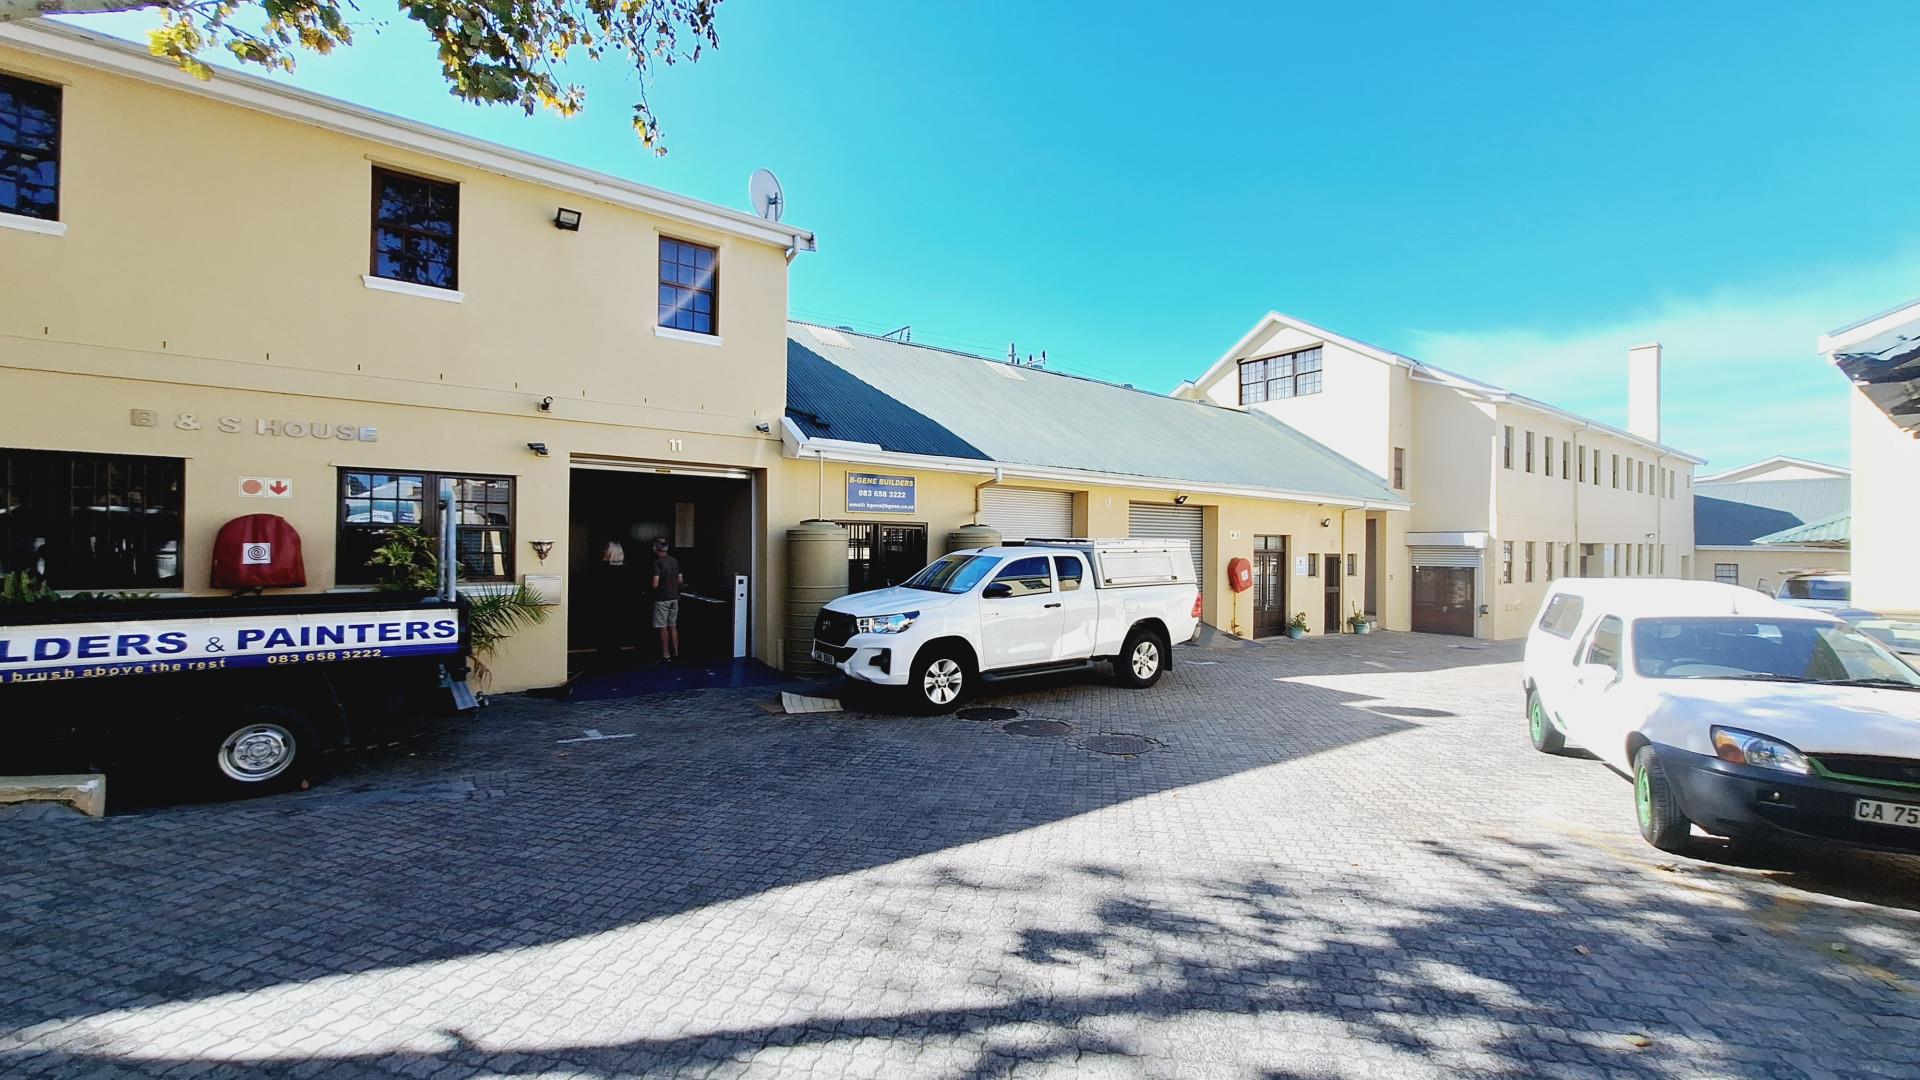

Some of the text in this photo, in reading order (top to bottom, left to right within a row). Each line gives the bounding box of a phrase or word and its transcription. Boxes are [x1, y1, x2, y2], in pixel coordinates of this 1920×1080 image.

[130, 408, 378, 442] B & S HOUSE
[669, 438, 682, 452] 11
[849, 476, 878, 484] B-GENE
[858, 489, 906, 499] 083 658 3222
[205, 636, 225, 653] &
[237, 620, 456, 650] PAINTERS
[267, 648, 382, 665] 083 658 3222
[12, 668, 75, 683] brush
[82, 665, 144, 679] above
[151, 661, 182, 673] the
[188, 657, 226, 670] rest
[1859, 802, 1920, 823] CA 75
